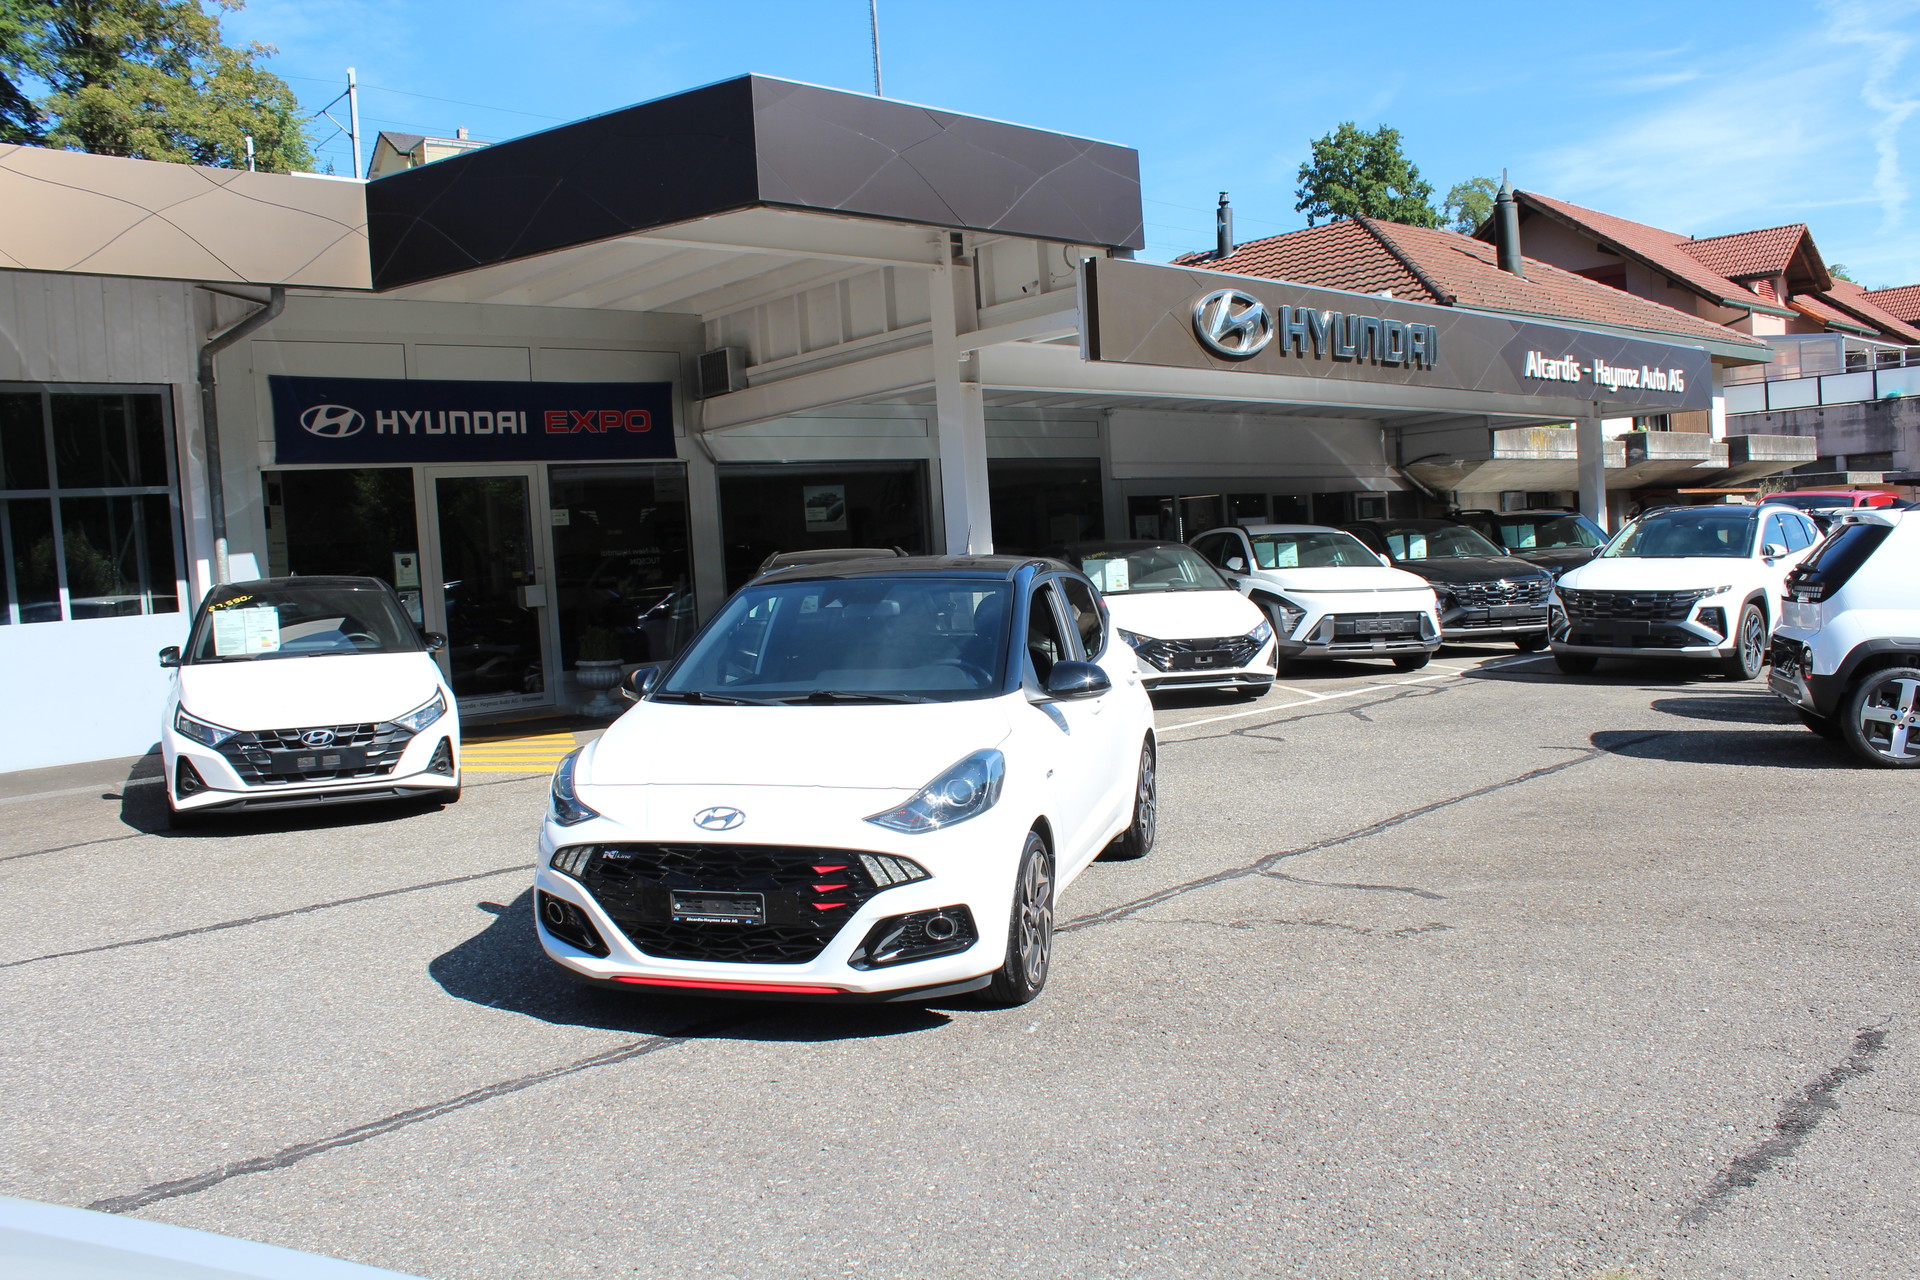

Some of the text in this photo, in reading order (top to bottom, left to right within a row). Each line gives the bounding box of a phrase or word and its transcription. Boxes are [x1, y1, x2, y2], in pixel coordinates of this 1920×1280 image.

[1279, 304, 1438, 368] HYUNDAI
[1592, 358, 1640, 393] Haymoz
[1640, 364, 1667, 391] Auto
[1667, 368, 1685, 393] AG
[376, 409, 652, 435] HYUNDAI EXPO
